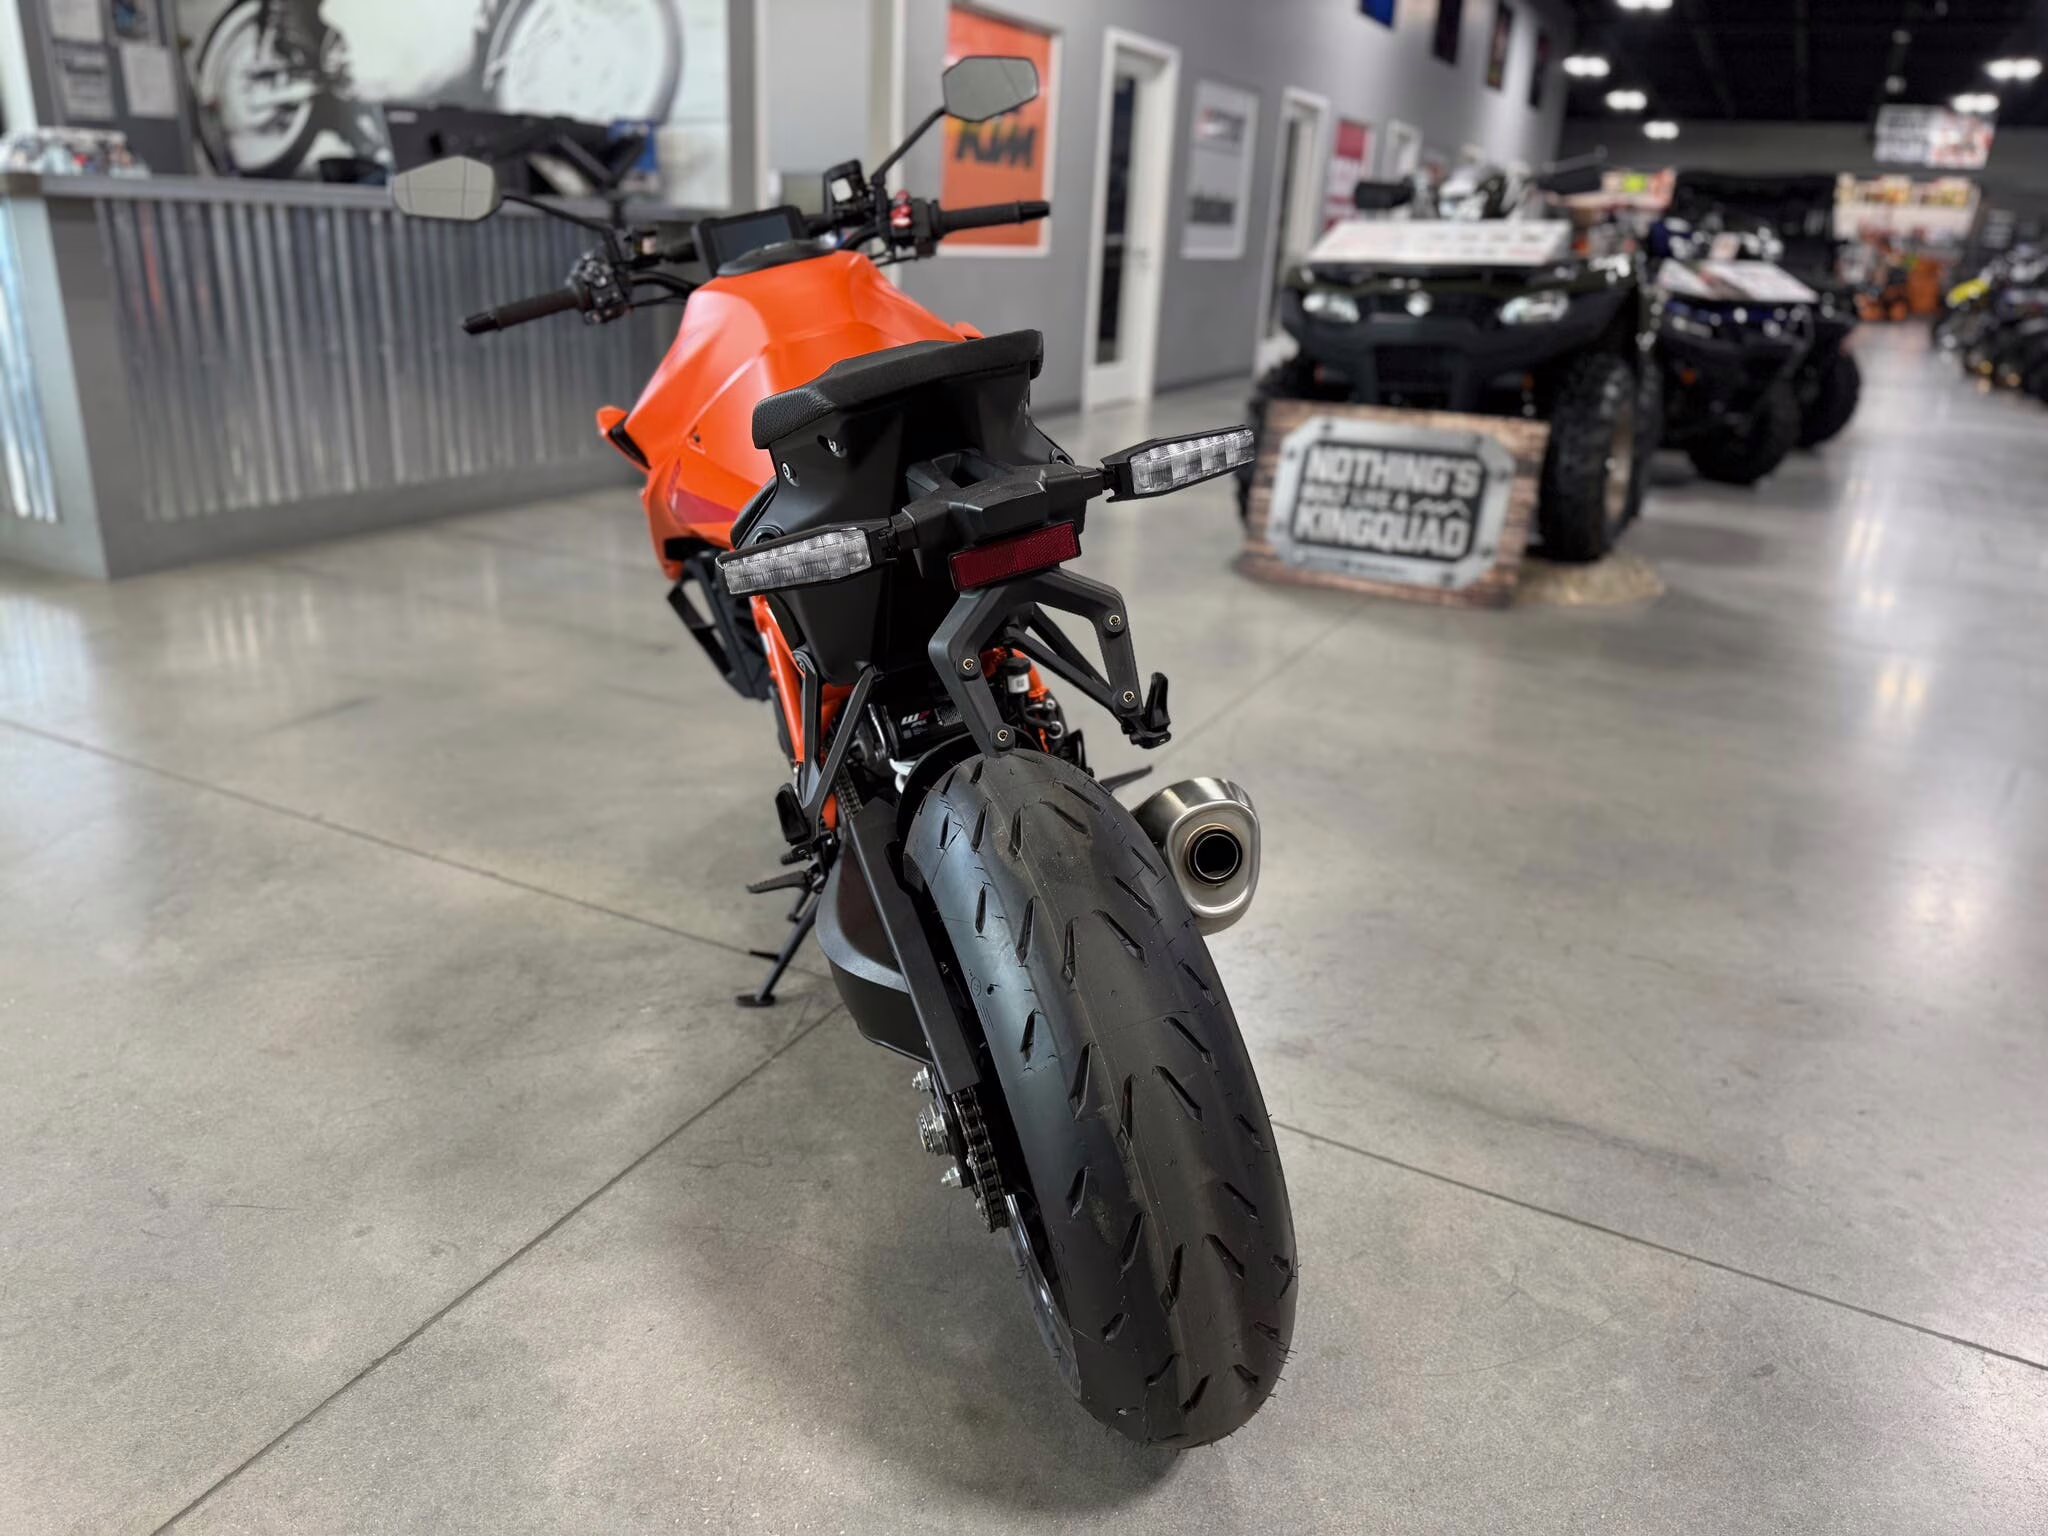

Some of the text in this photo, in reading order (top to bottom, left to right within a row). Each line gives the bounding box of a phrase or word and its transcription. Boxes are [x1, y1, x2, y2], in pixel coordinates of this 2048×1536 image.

[956, 120, 1036, 170] KTM
[1305, 445, 1481, 498] NOTHING'S
[1294, 503, 1472, 558] KINGQUAD
